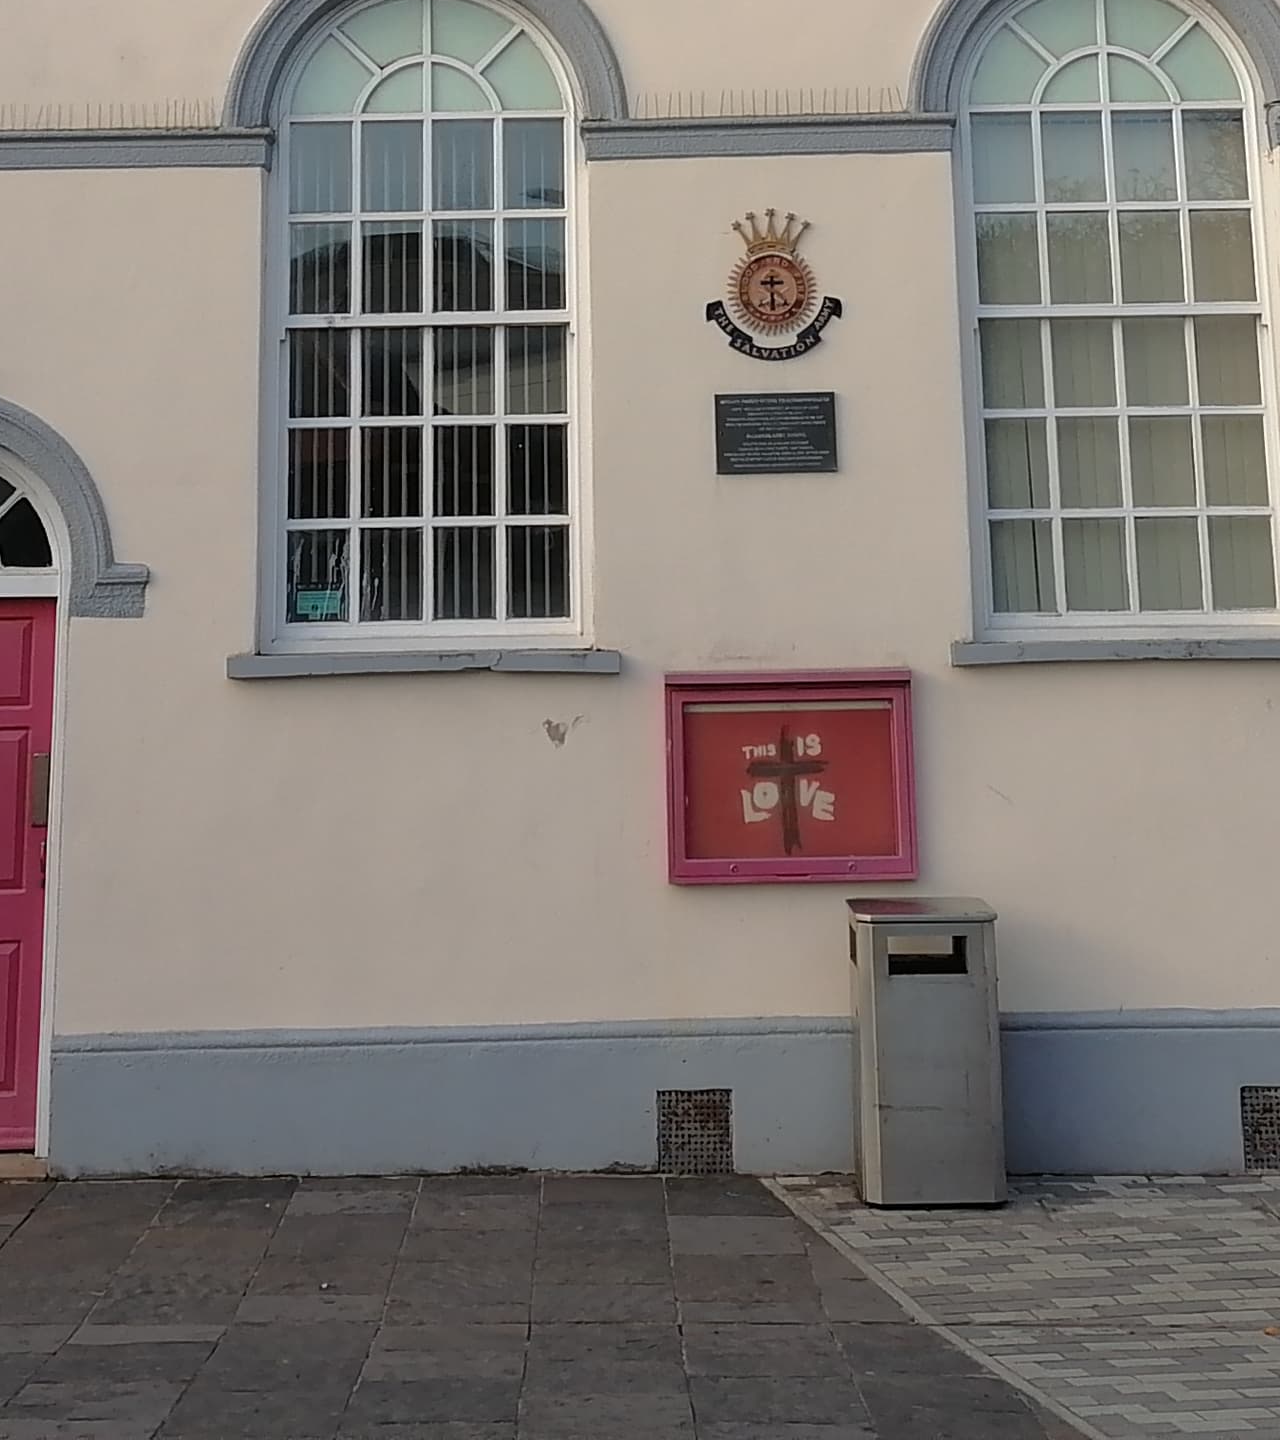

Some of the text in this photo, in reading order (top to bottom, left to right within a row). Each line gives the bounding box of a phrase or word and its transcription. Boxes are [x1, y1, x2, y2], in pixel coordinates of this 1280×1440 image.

[714, 299, 832, 359] THE SALVATION ARMY
[742, 733, 822, 760] THIS IS
[740, 778, 836, 825] LOVE
